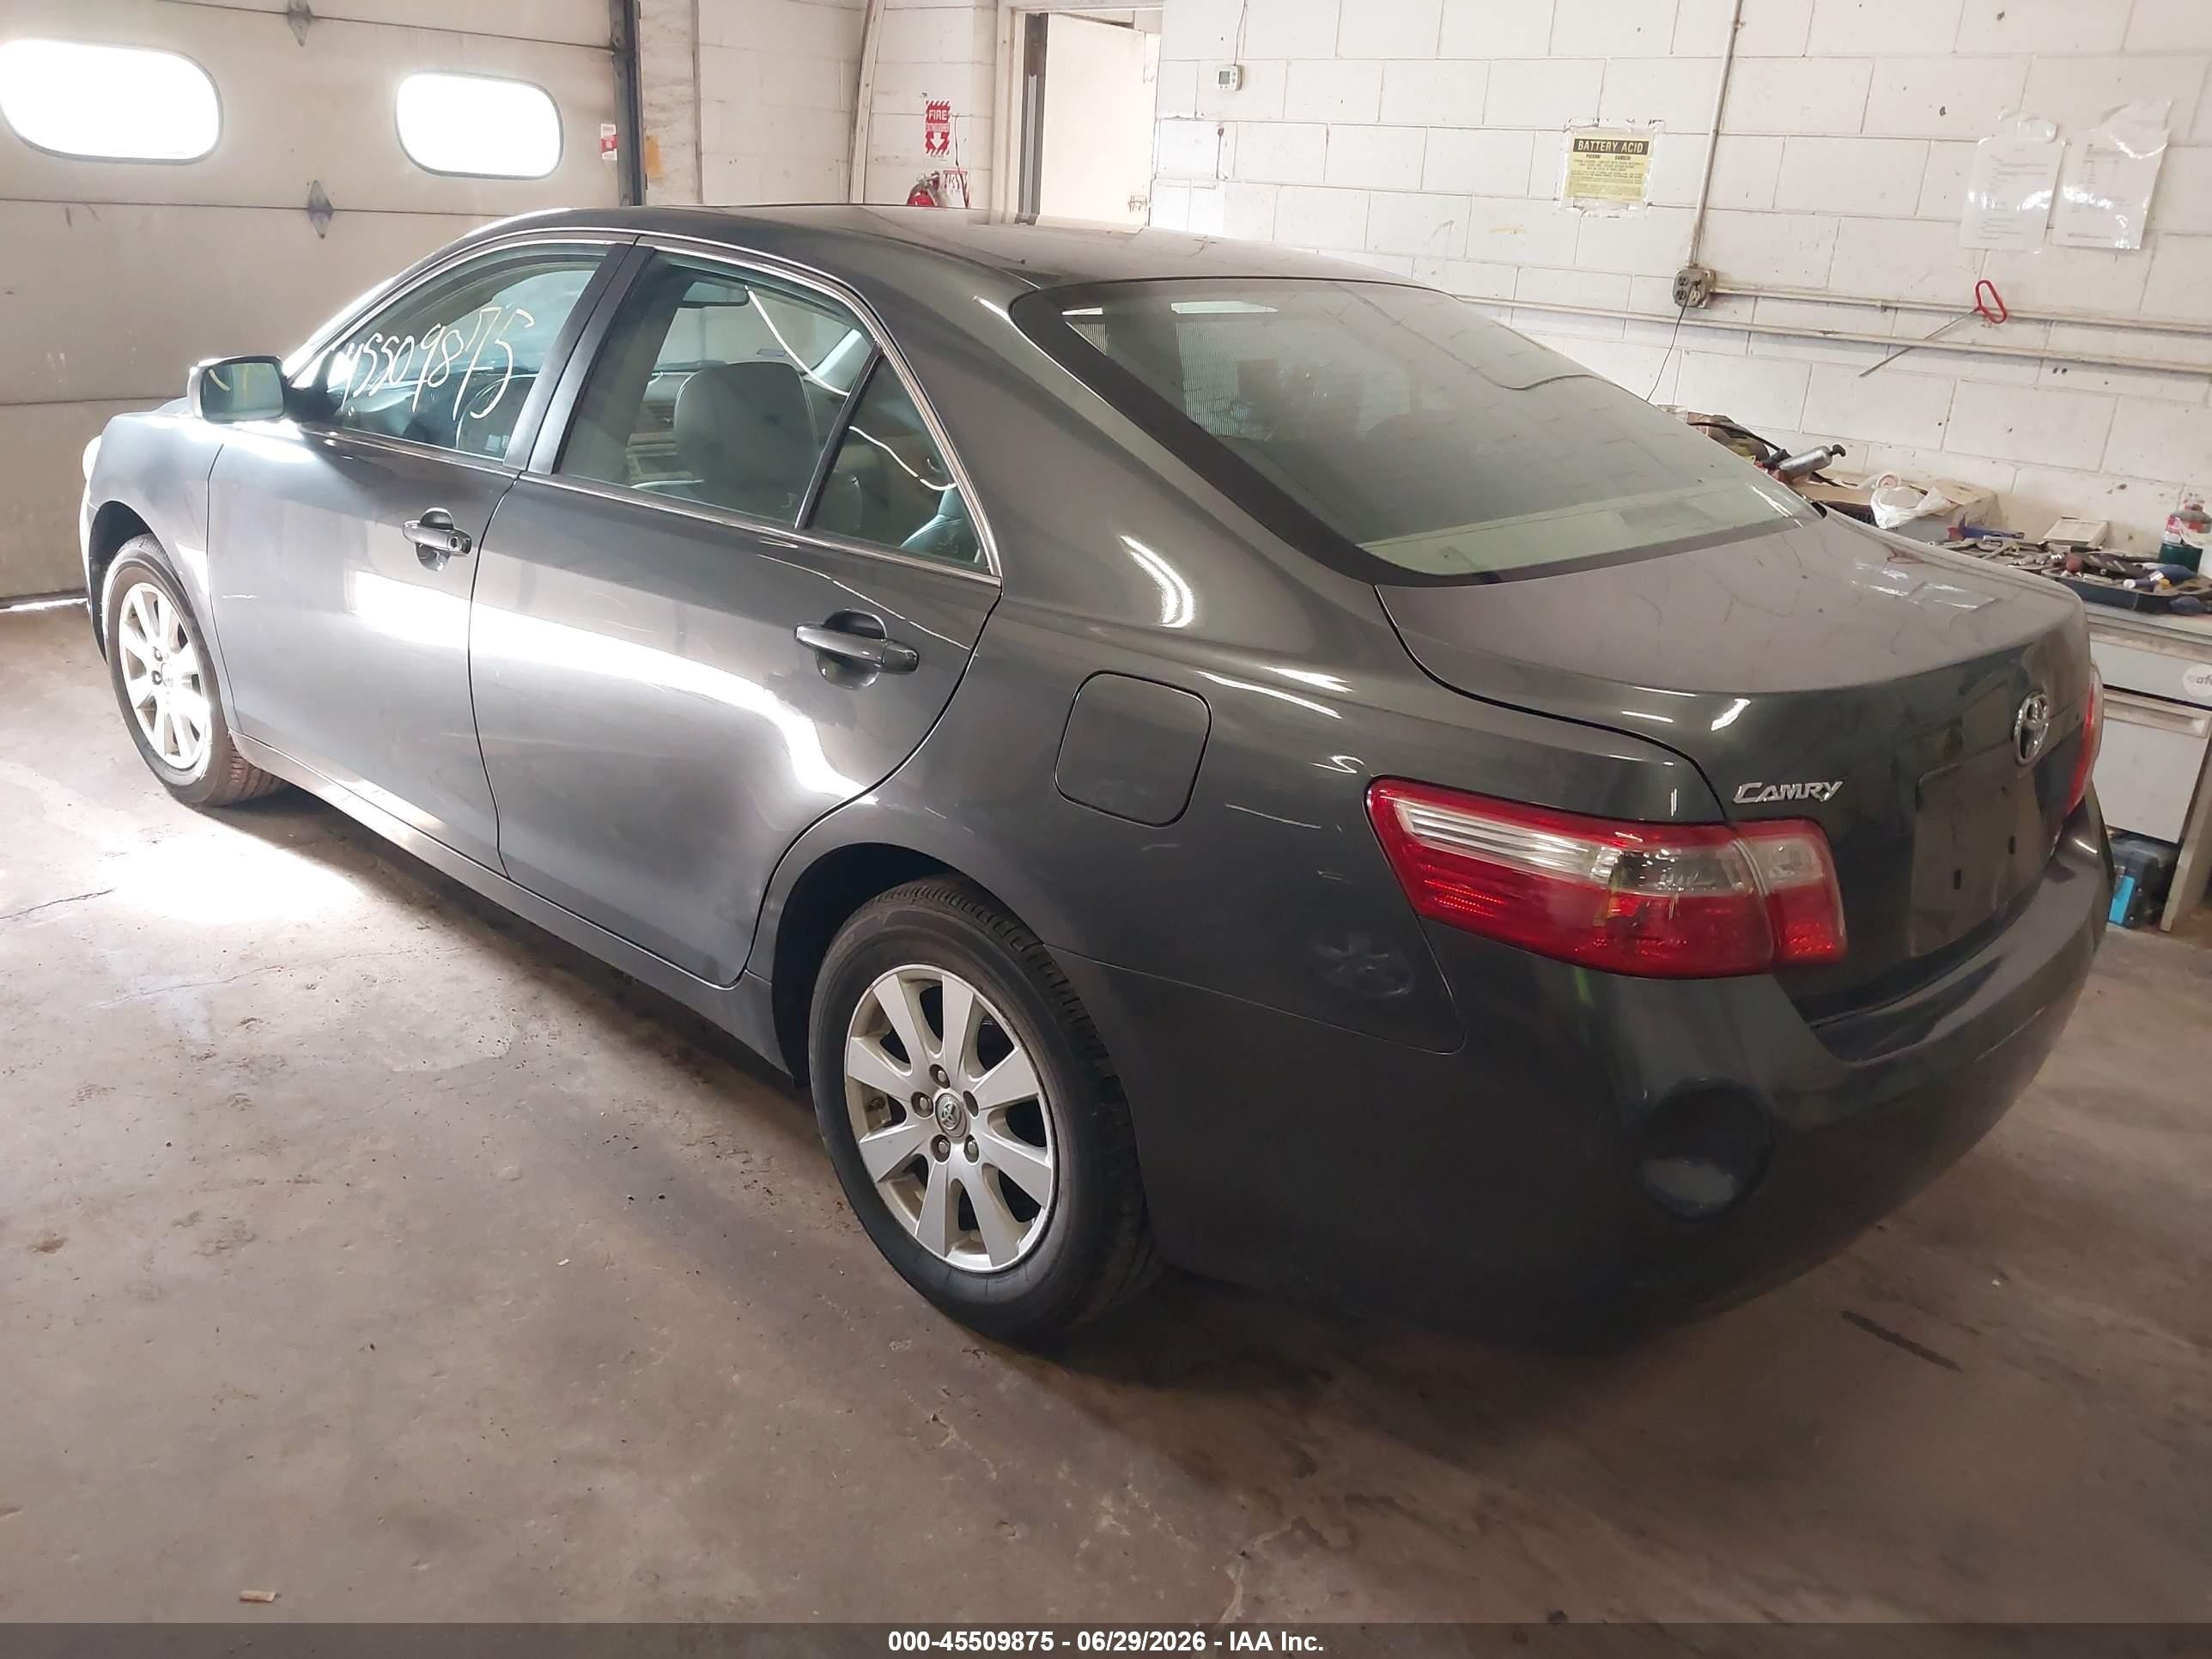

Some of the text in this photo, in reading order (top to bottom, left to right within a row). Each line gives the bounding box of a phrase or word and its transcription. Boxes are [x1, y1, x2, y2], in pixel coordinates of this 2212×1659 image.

[928, 109, 948, 120] FIRE
[1577, 140, 1644, 154] BATTERY ACID
[1733, 781, 1844, 804] CAMRY
